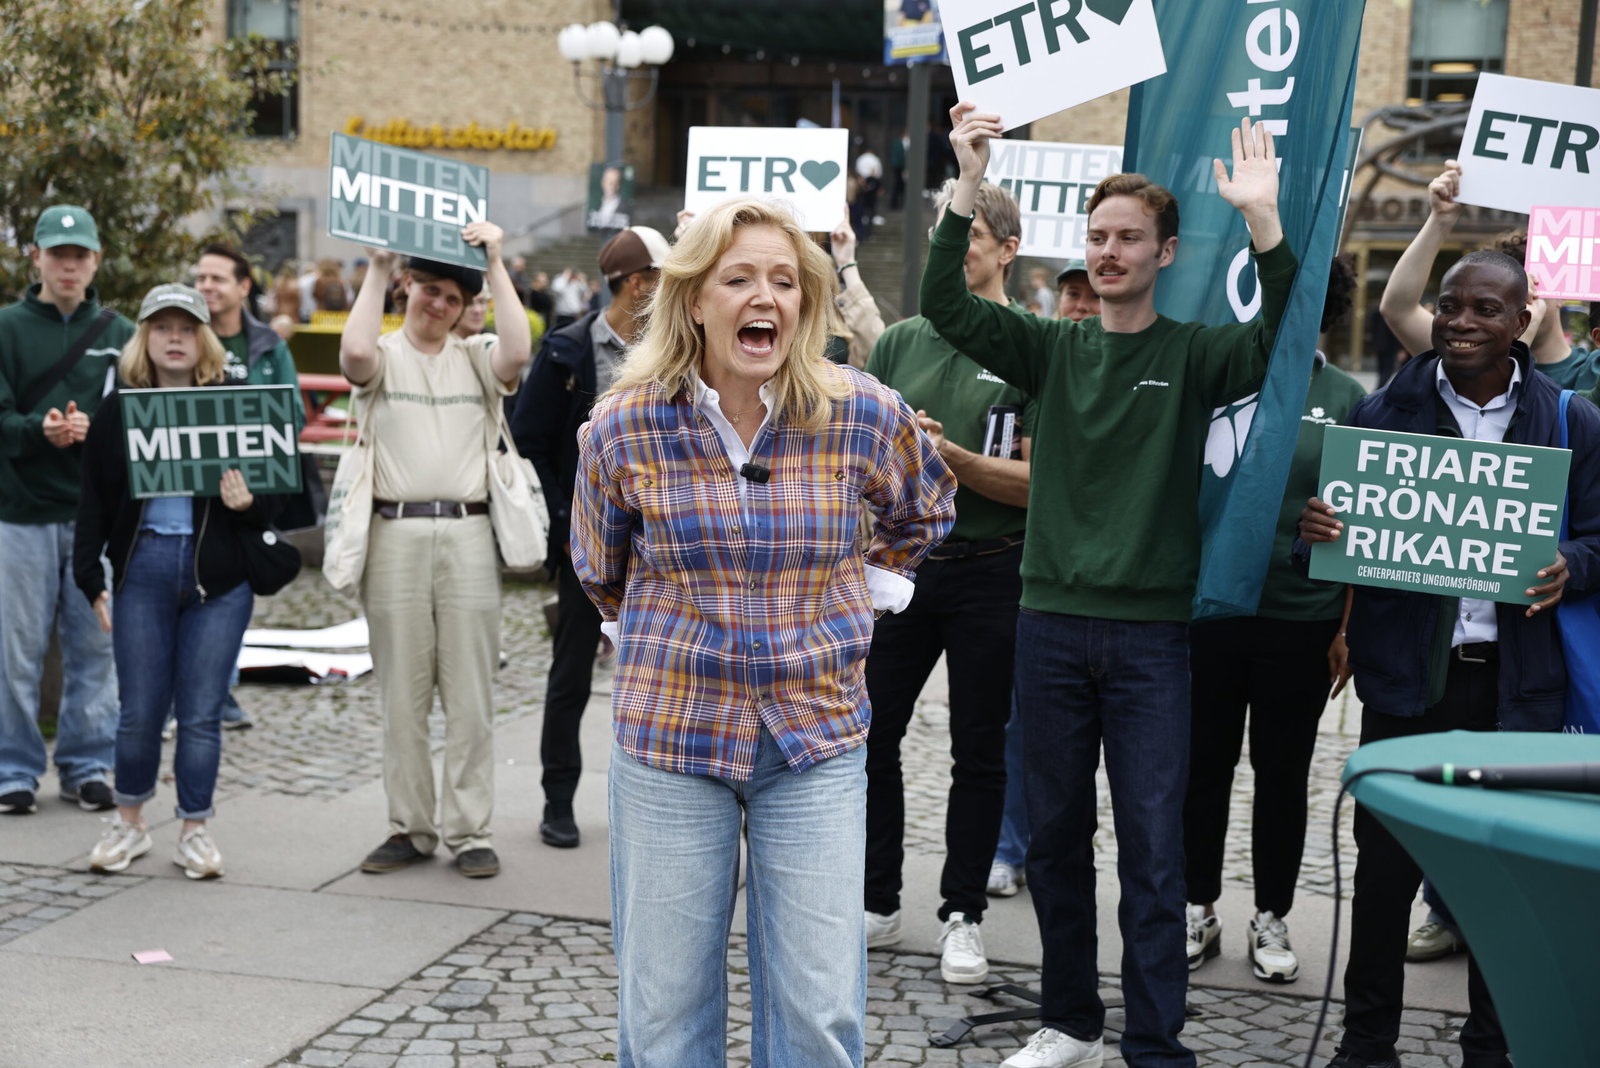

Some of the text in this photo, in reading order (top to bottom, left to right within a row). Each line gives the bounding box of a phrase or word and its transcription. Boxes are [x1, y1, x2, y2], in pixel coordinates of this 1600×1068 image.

[334, 135, 487, 198] MITTEN
[697, 156, 798, 193] ETR
[331, 165, 487, 227] MITTEN
[124, 391, 293, 428] MITTEN
[127, 423, 296, 462] MITTEN
[1357, 439, 1533, 490] FRIARE
[1322, 478, 1558, 537] GRÖNARE
[1345, 525, 1522, 577] RIKARE
[1357, 565, 1501, 593] CENTERPARTIETS UNGDOMSFÖRBUND
